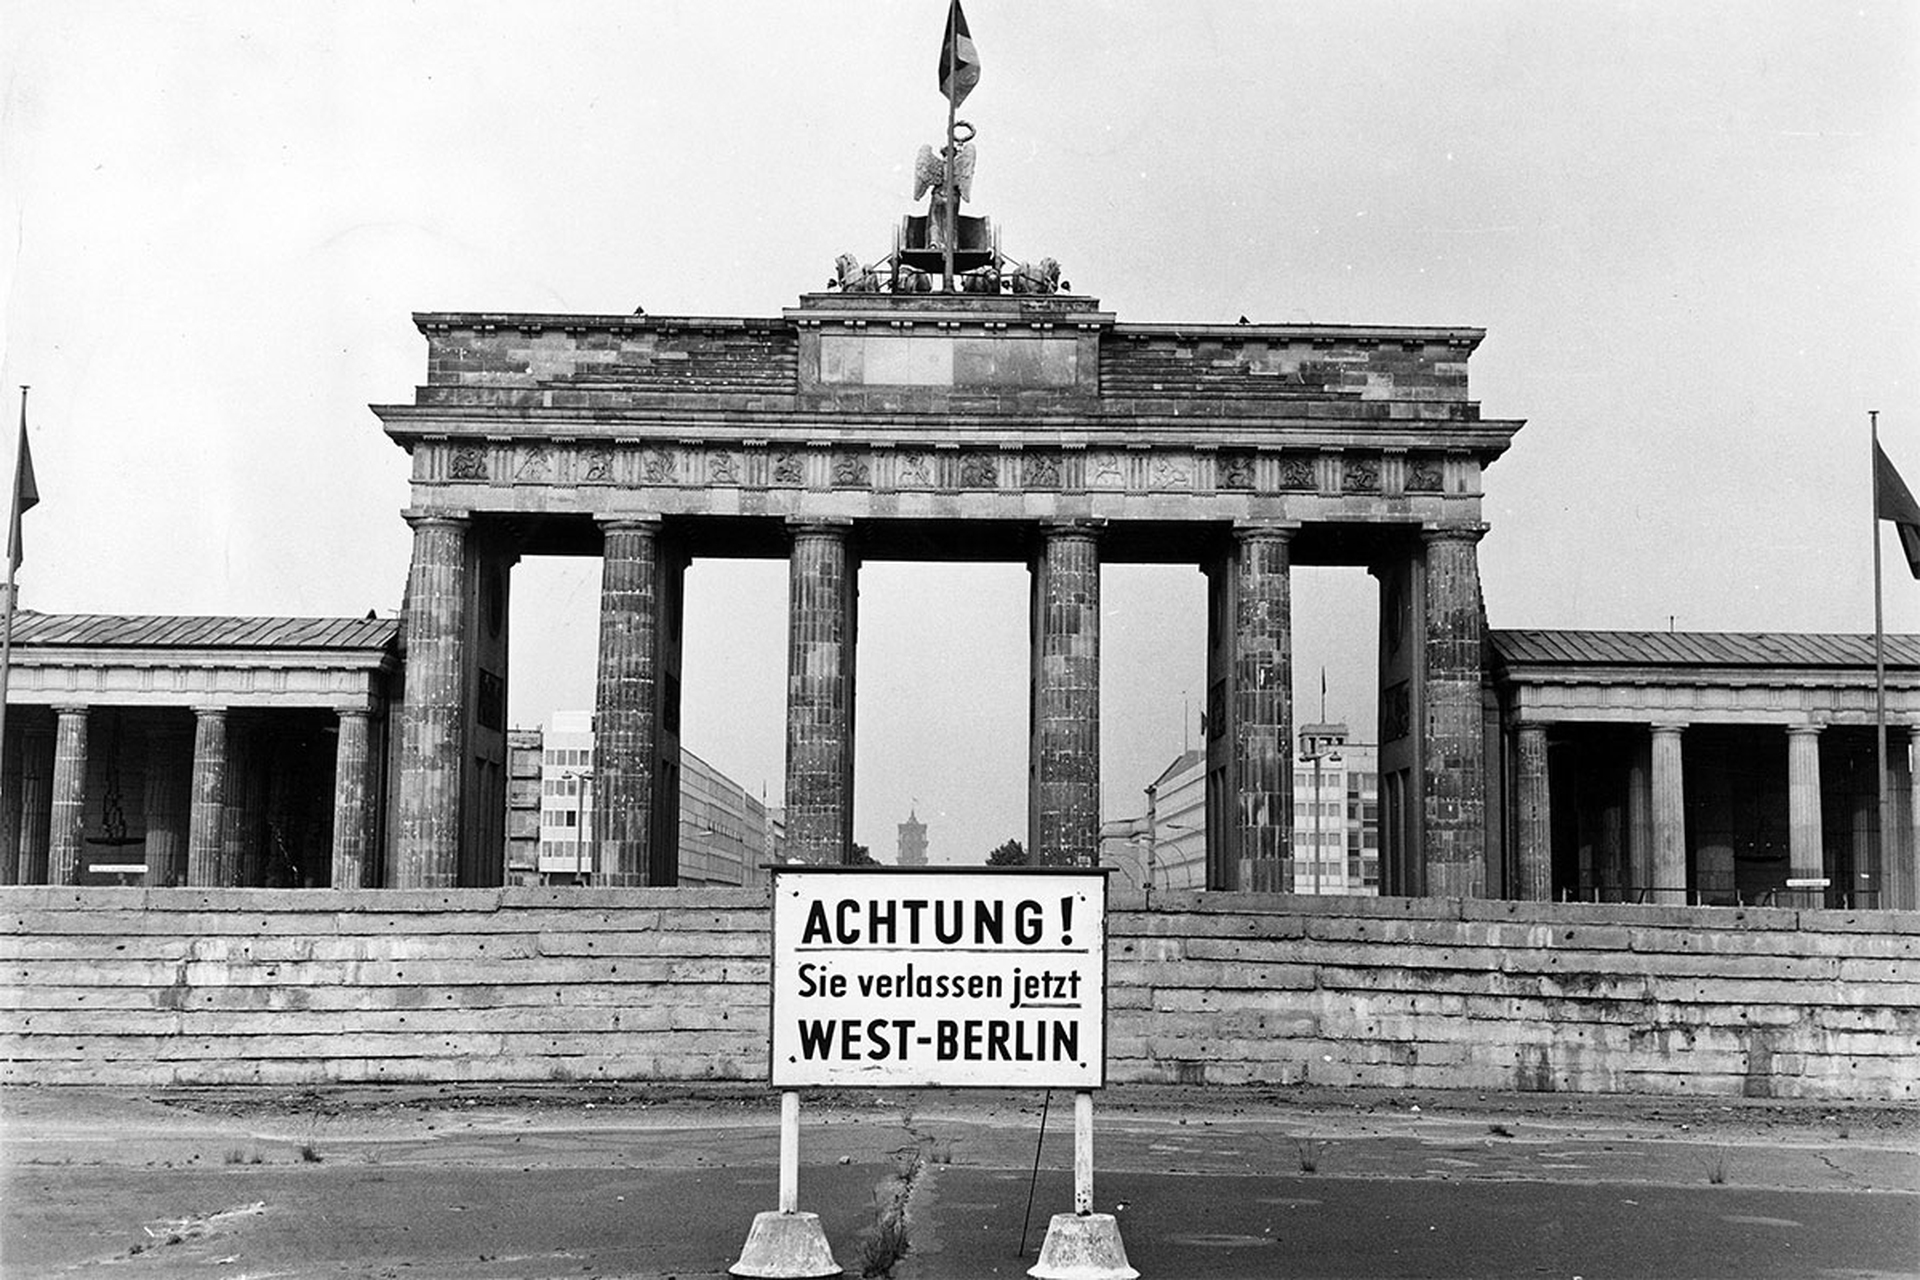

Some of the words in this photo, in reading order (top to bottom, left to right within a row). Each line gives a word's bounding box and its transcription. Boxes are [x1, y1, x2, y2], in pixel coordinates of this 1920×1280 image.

[798, 963, 847, 998] Sie
[857, 962, 1003, 998] verlassen
[1009, 967, 1082, 1009] jetzt
[798, 1018, 1079, 1062] WEST-BERLIN
